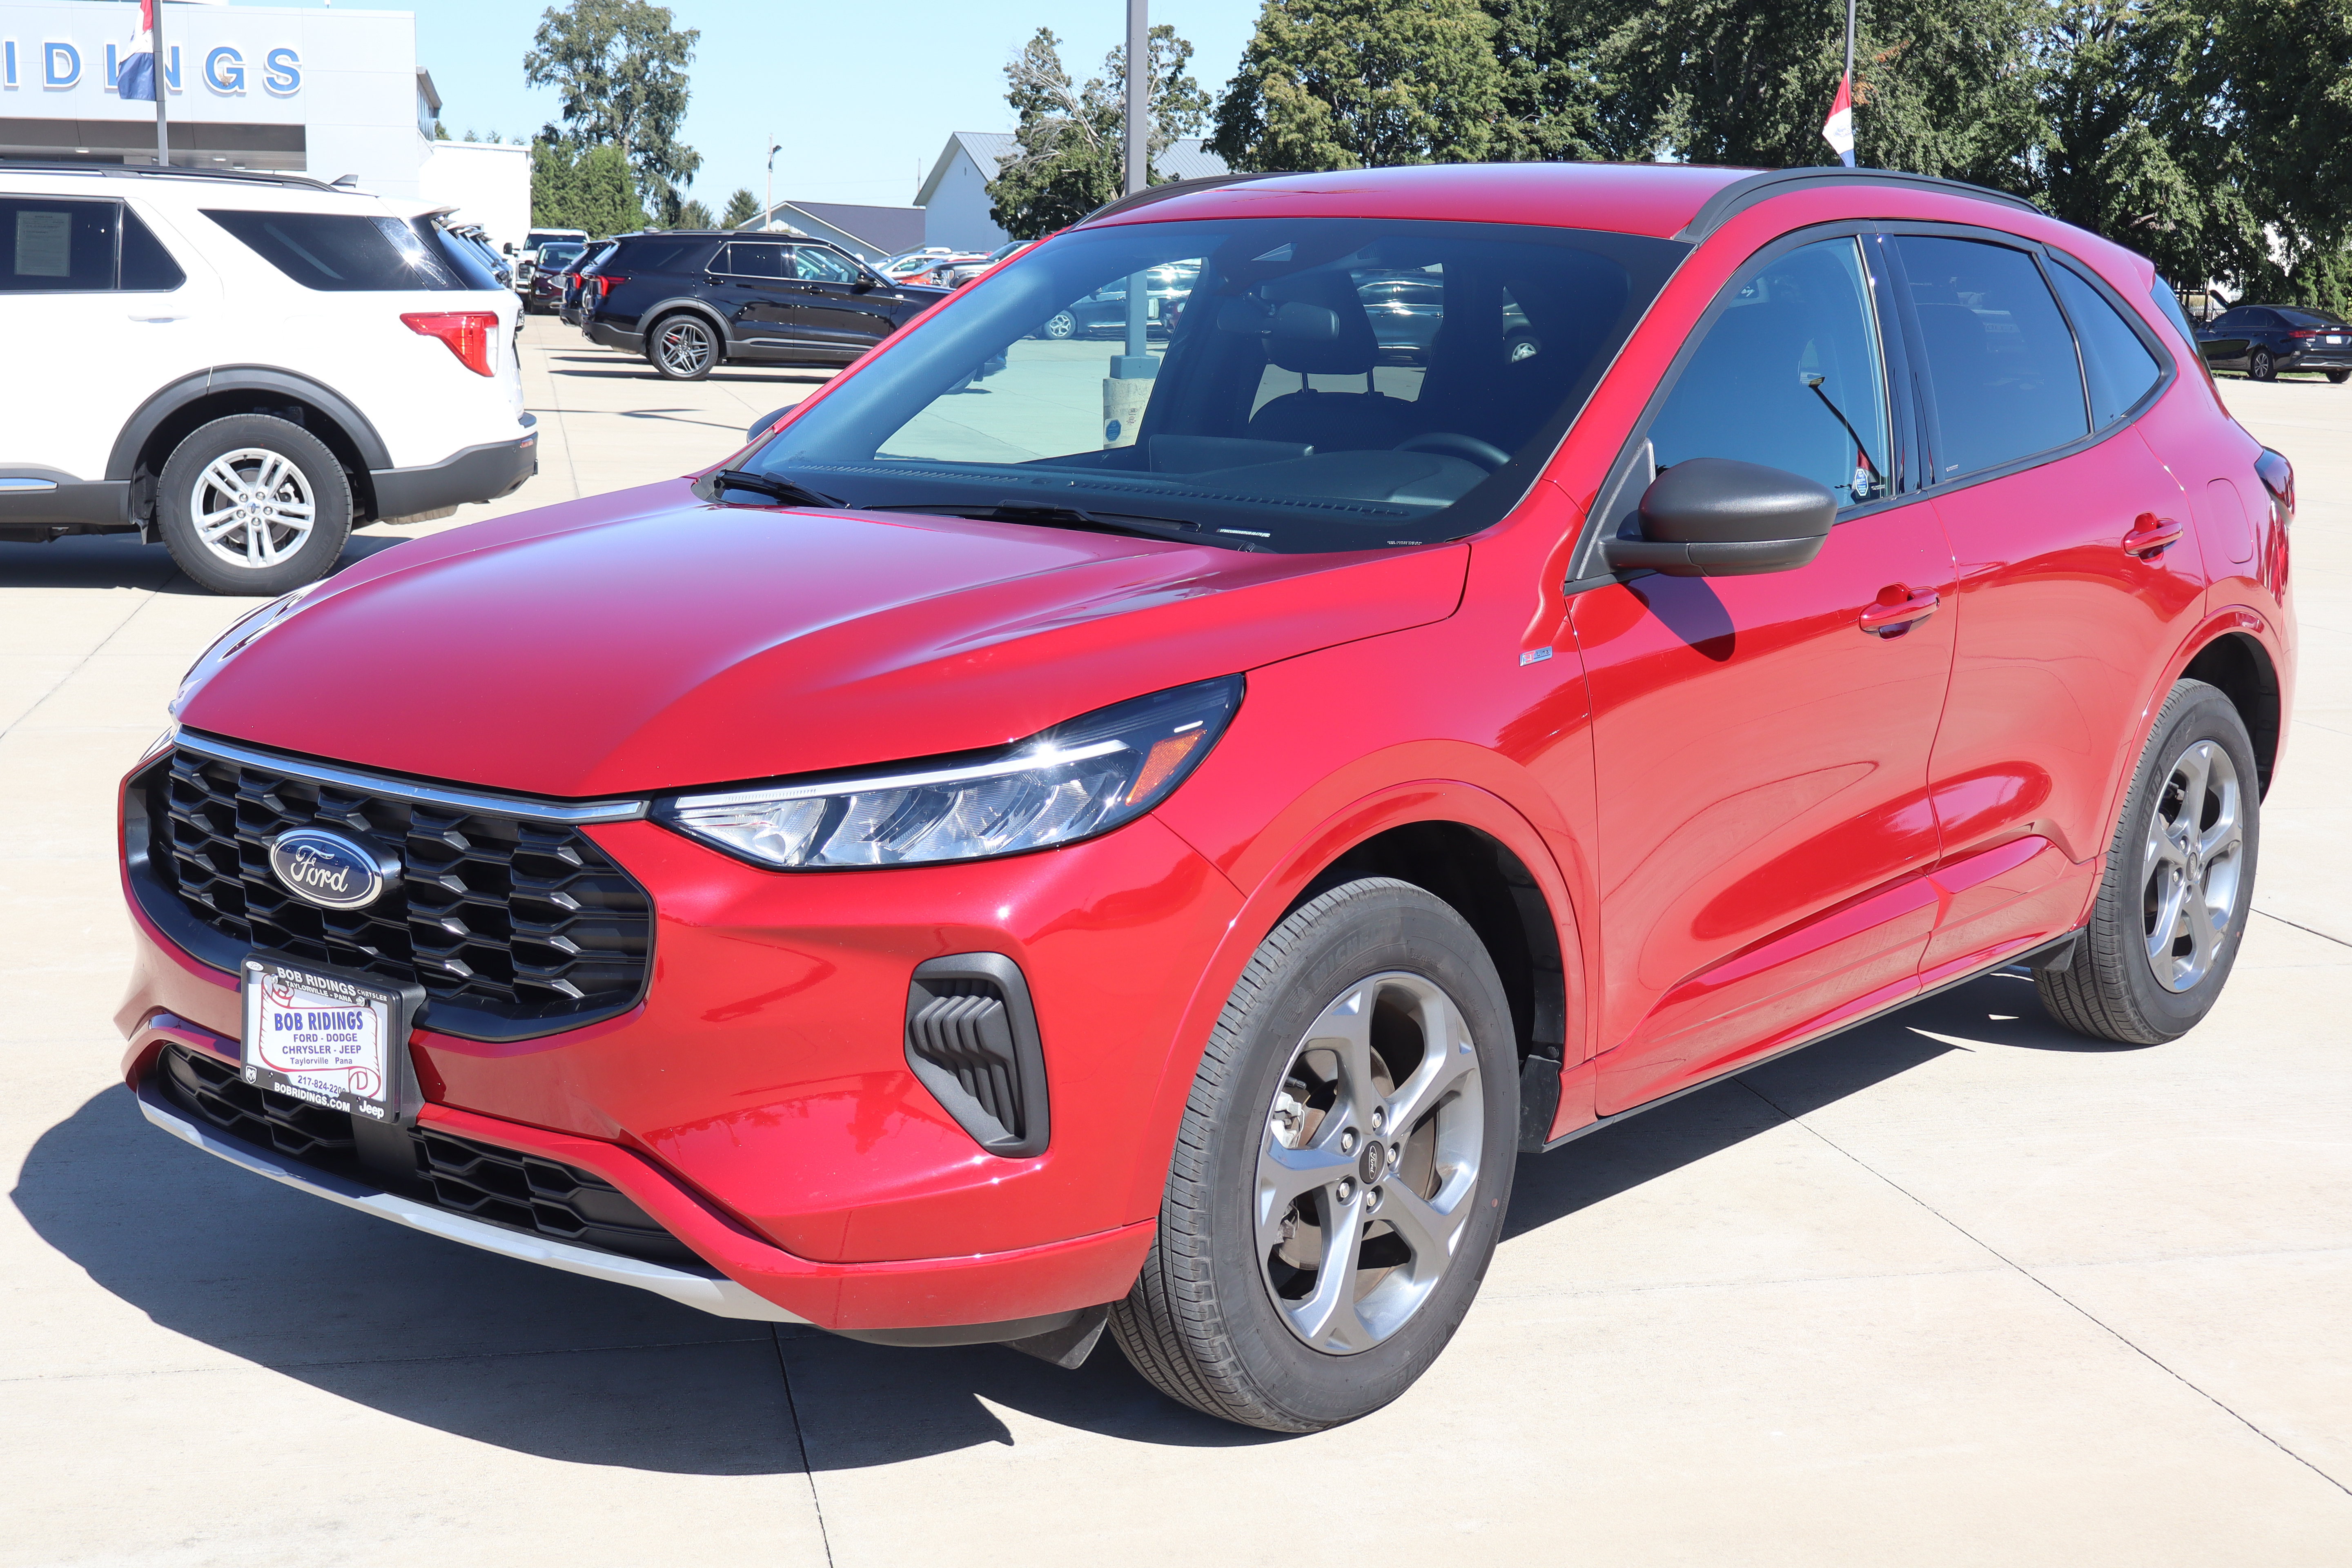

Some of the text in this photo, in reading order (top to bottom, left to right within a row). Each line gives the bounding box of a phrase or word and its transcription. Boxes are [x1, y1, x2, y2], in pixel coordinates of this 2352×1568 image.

[291, 845, 350, 893] Ford
[277, 967, 356, 996] BOB RIDINGS
[285, 980, 329, 997] TAYLORVILLE
[334, 993, 353, 1003] PANA
[357, 989, 388, 1002] CHRYSLER
[274, 1011, 363, 1031] BOB RIDINGS
[294, 1033, 318, 1042] FORD
[326, 1033, 358, 1042] DODGE
[282, 1045, 331, 1054] CHRYSLER
[339, 1045, 361, 1054] JEEP
[290, 1057, 329, 1066] Taylorville
[274, 1082, 350, 1112] BOBRIDINGS.COM
[359, 1100, 385, 1120] Jeep
